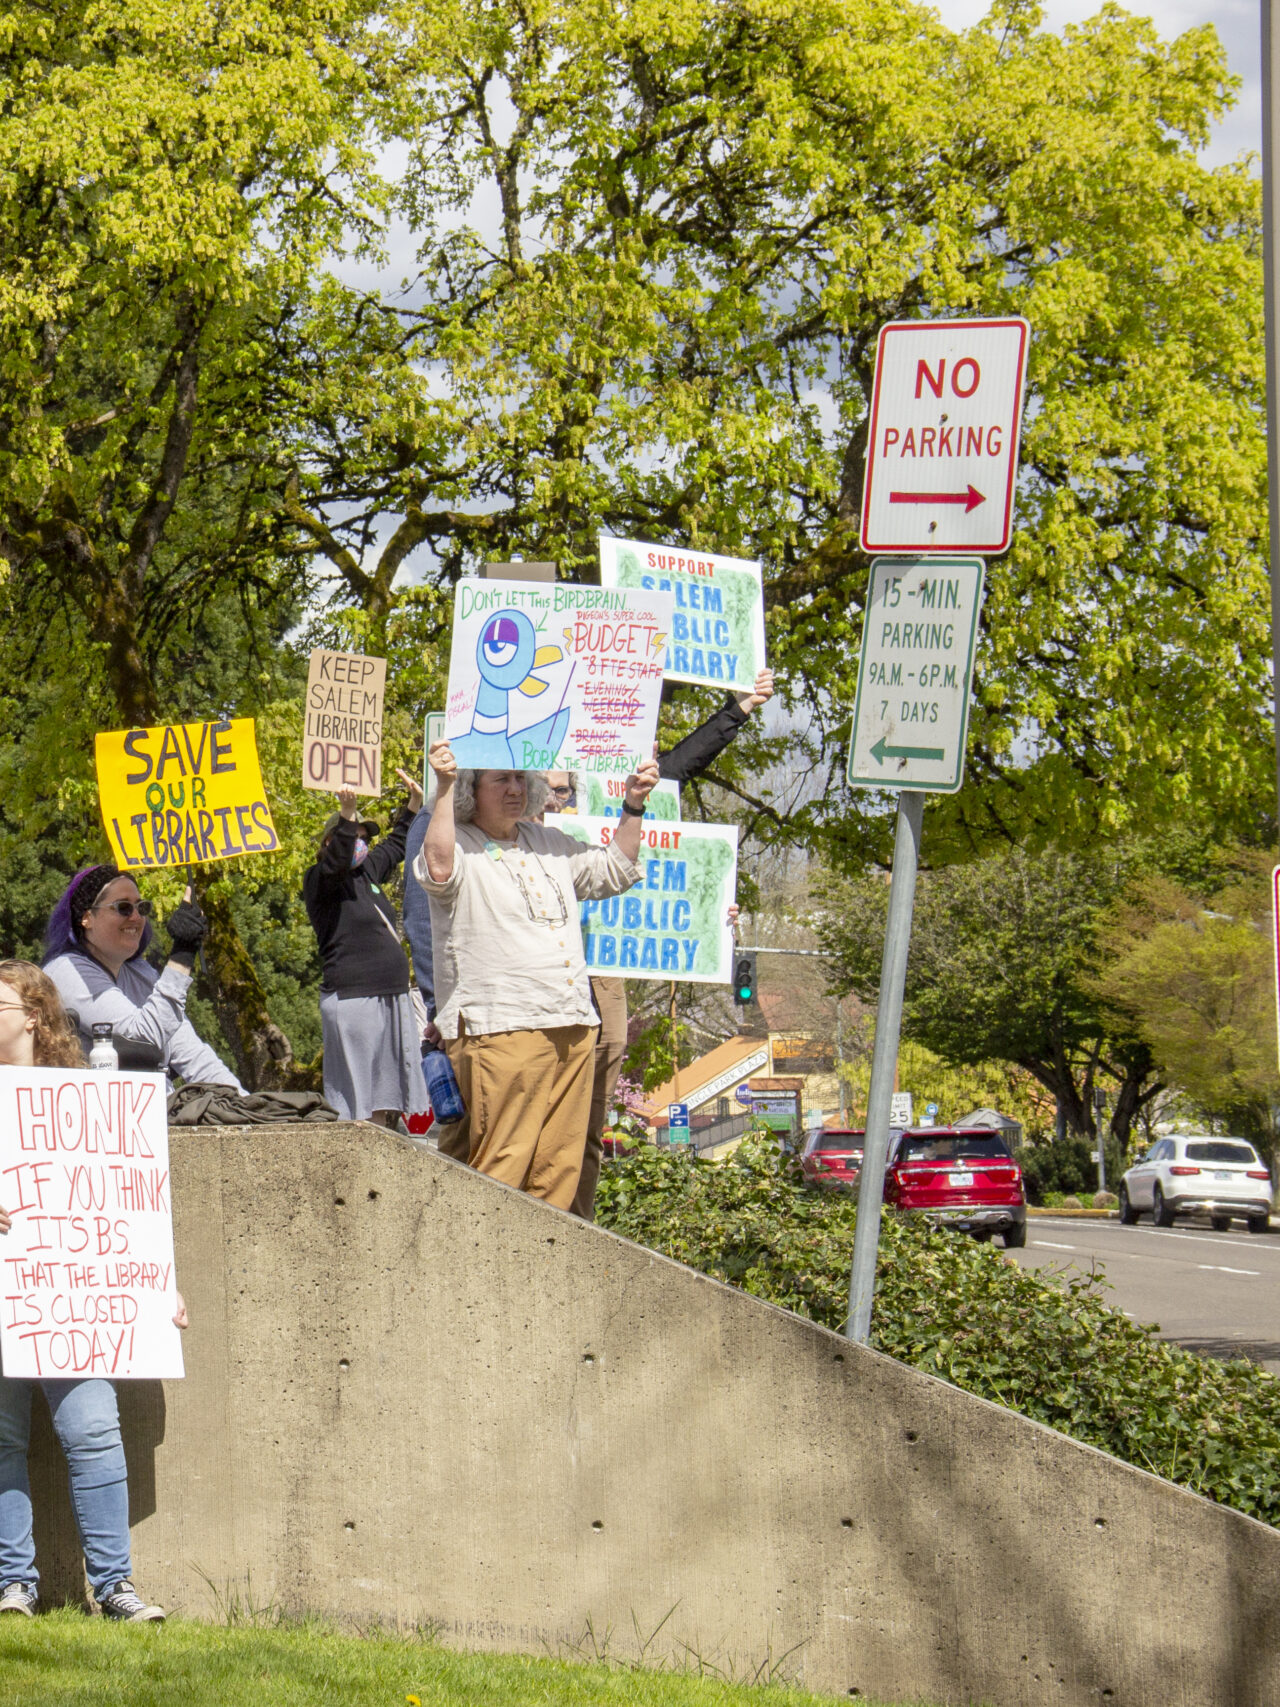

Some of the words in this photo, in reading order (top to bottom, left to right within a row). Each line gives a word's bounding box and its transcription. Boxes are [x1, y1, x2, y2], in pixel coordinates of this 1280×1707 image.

[915, 357, 981, 399] NO
[883, 425, 1003, 458] PARKING
[648, 553, 714, 577] SUPPORT
[461, 586, 502, 620] DON'T
[506, 591, 526, 605] LET
[576, 610, 610, 621] PIGEON'S
[613, 610, 634, 621] SUPER
[637, 611, 656, 620] COOL
[574, 622, 659, 657] BUDGET
[673, 613, 729, 647] BLIC
[881, 622, 954, 650] PARKING
[320, 655, 375, 685] KEEP
[601, 658, 627, 677] FTE
[628, 662, 663, 680] STAFF
[310, 683, 377, 718] SALEM
[583, 697, 640, 713] WEEKEND
[880, 700, 889, 721] 7
[901, 701, 939, 723] DAYS
[307, 712, 380, 746] LIBRARIES
[595, 711, 637, 727] SERVICE
[123, 721, 237, 785] SAVE
[309, 741, 377, 789] OPEN
[522, 741, 562, 770] BORK
[564, 757, 582, 771] THE
[580, 744, 627, 759] SERVICE
[146, 777, 206, 812] OUR
[112, 801, 277, 865] LIBRARIES
[580, 896, 691, 932] PUBLIC
[586, 933, 700, 971] IBRARY
[16, 1082, 155, 1158] HONK
[890, 1111, 908, 1122] 25
[2, 1162, 53, 1214] IF
[64, 1165, 106, 1211] YOU
[109, 1165, 168, 1213] THINK
[26, 1215, 89, 1253] IT'S
[94, 1216, 131, 1255] B.S.
[5, 1259, 61, 1289] THAT
[64, 1263, 100, 1289] THE
[106, 1261, 171, 1291] LIBRARY
[5, 1294, 43, 1329] IS
[51, 1294, 138, 1325] CLOSED
[19, 1326, 135, 1376] TODAY!
